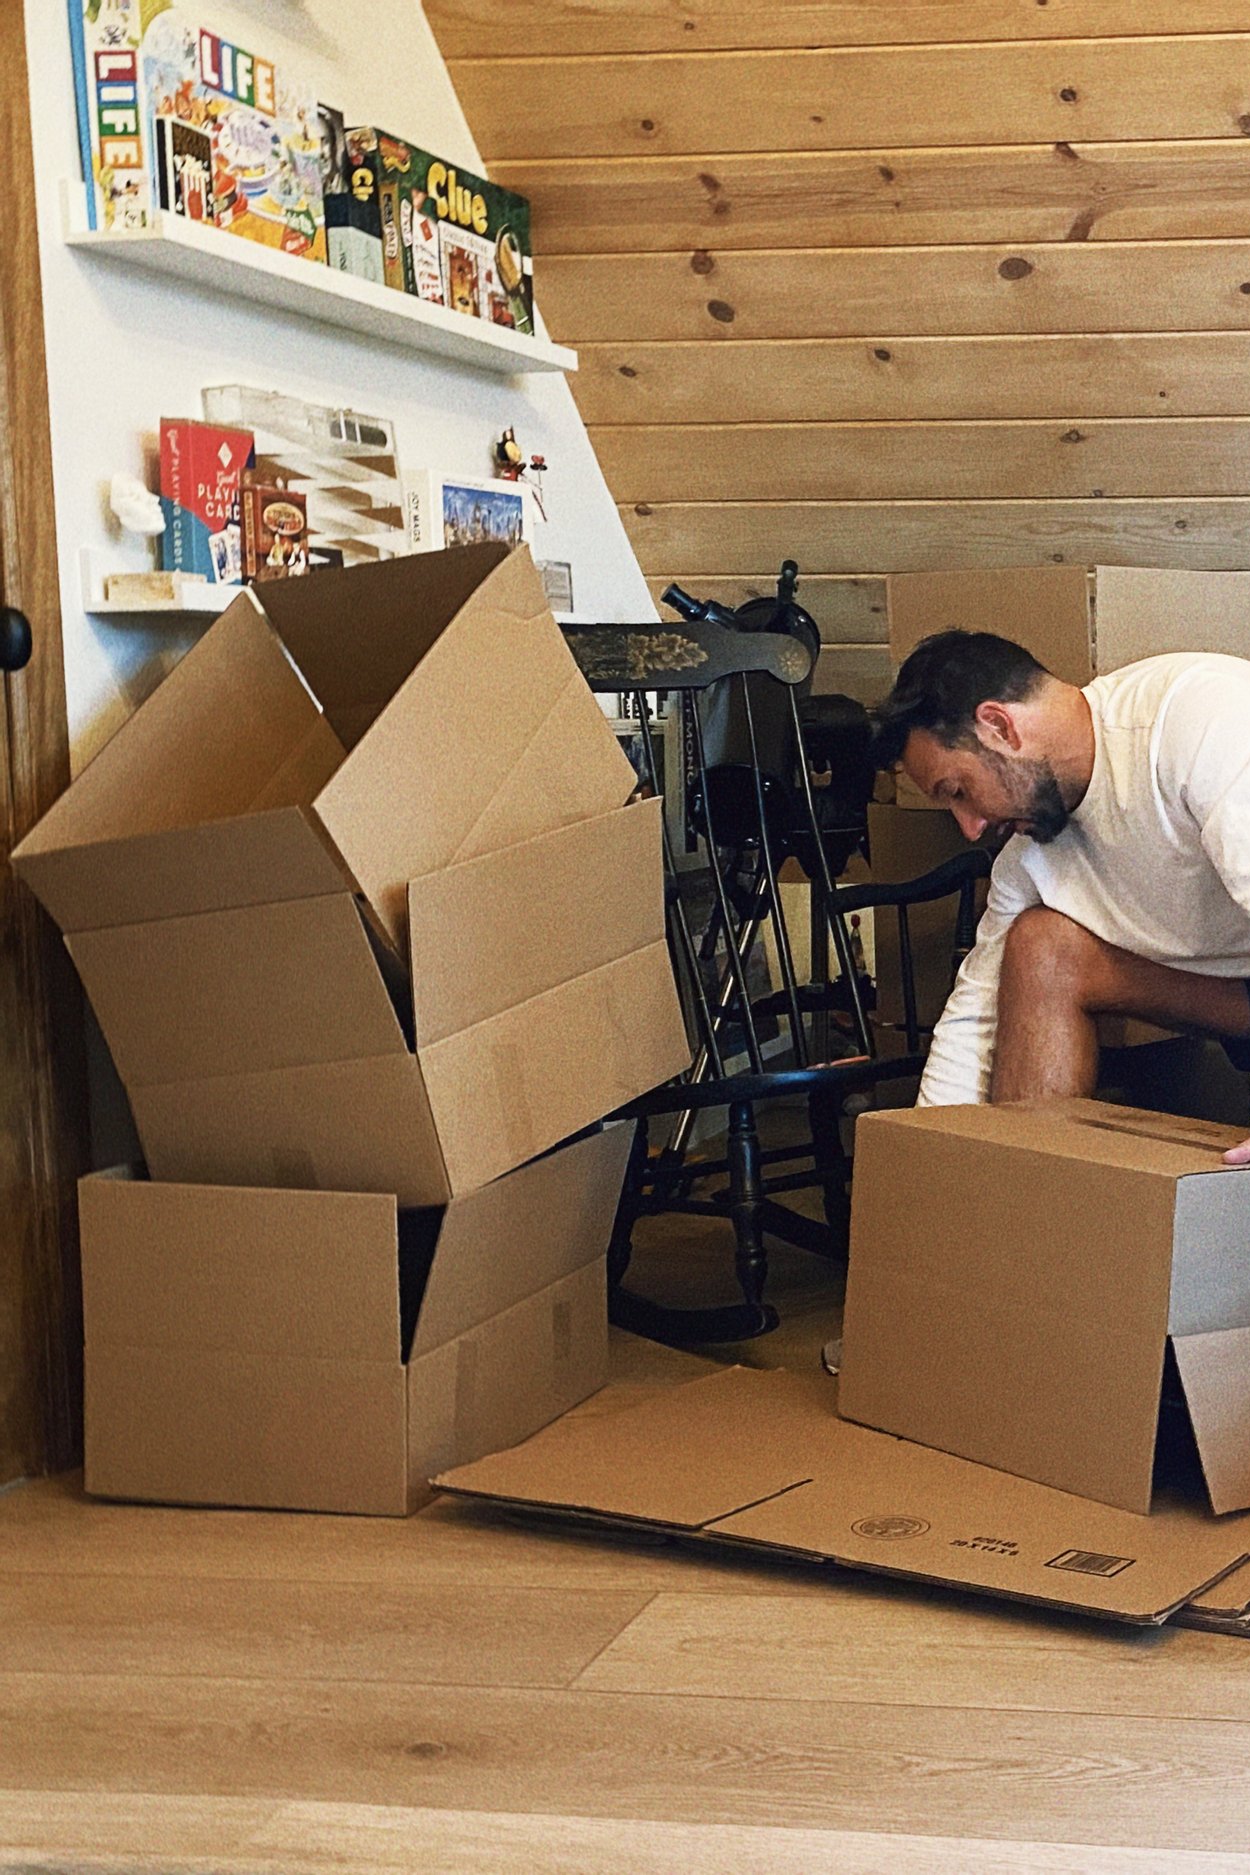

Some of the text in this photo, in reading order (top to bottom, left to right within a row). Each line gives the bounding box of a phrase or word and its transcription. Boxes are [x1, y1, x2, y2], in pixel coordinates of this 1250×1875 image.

[201, 31, 274, 115] LIFE
[97, 52, 140, 167] LIFE
[351, 167, 374, 201] Cl
[427, 161, 488, 234] Clue
[171, 457, 181, 516] PLAYING
[198, 482, 240, 504] PLAYI
[205, 501, 240, 521] CARD
[173, 519, 183, 564] CARDS
